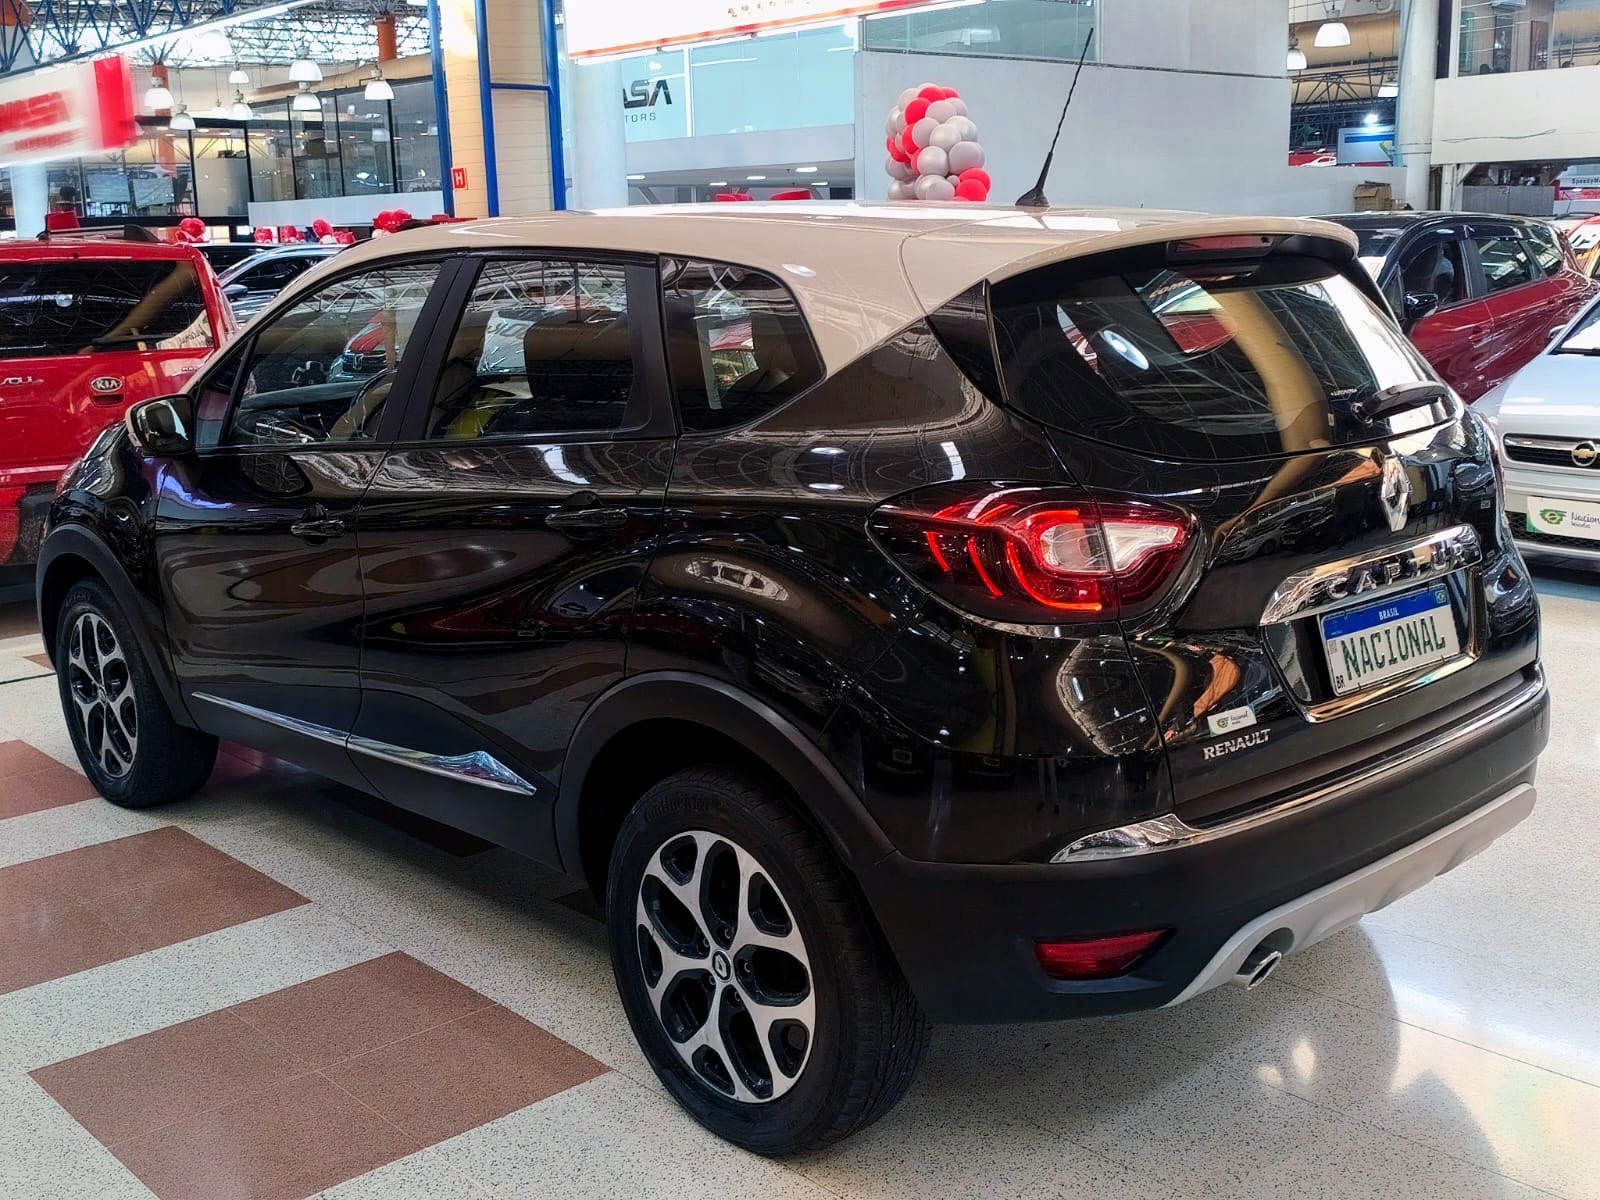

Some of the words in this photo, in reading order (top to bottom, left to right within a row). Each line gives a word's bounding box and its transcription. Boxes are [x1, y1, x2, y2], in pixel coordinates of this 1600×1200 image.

[96, 379, 119, 390] KIA
[1378, 607, 1400, 621] BRASIL
[1341, 615, 1446, 681] NACIONAL
[1335, 674, 1346, 690] BR
[1203, 728, 1271, 760] RENAULT
